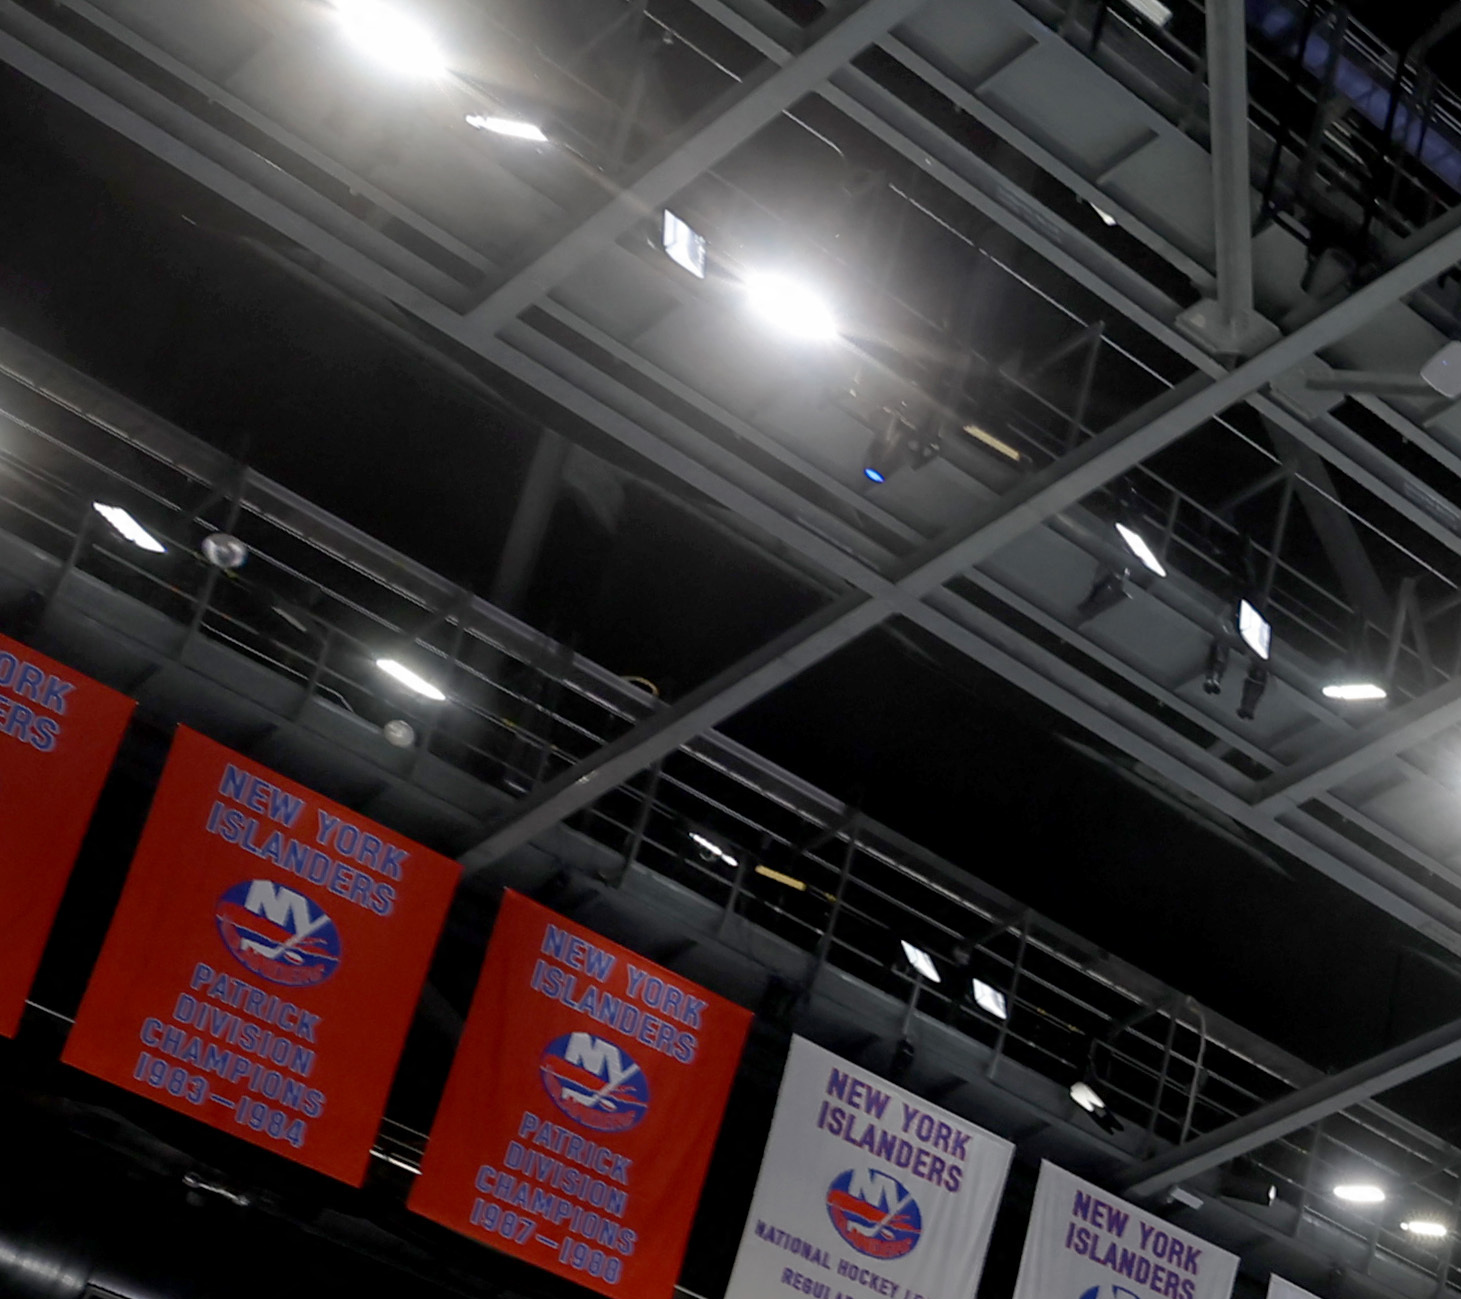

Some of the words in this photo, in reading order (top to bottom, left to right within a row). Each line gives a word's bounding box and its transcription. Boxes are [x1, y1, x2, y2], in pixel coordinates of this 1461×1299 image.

[204, 800, 399, 920] ISLANDERS
[218, 763, 304, 830] NEW
[315, 811, 410, 882] YORK
[171, 992, 315, 1078] DIVISION
[189, 960, 323, 1044] PATRICK
[138, 1015, 328, 1120] CHAMPIONS
[825, 1066, 889, 1121] NEW
[897, 1102, 970, 1162] YORK
[816, 1100, 963, 1194] ISLANDERS
[751, 1218, 833, 1271] NATIONAL
